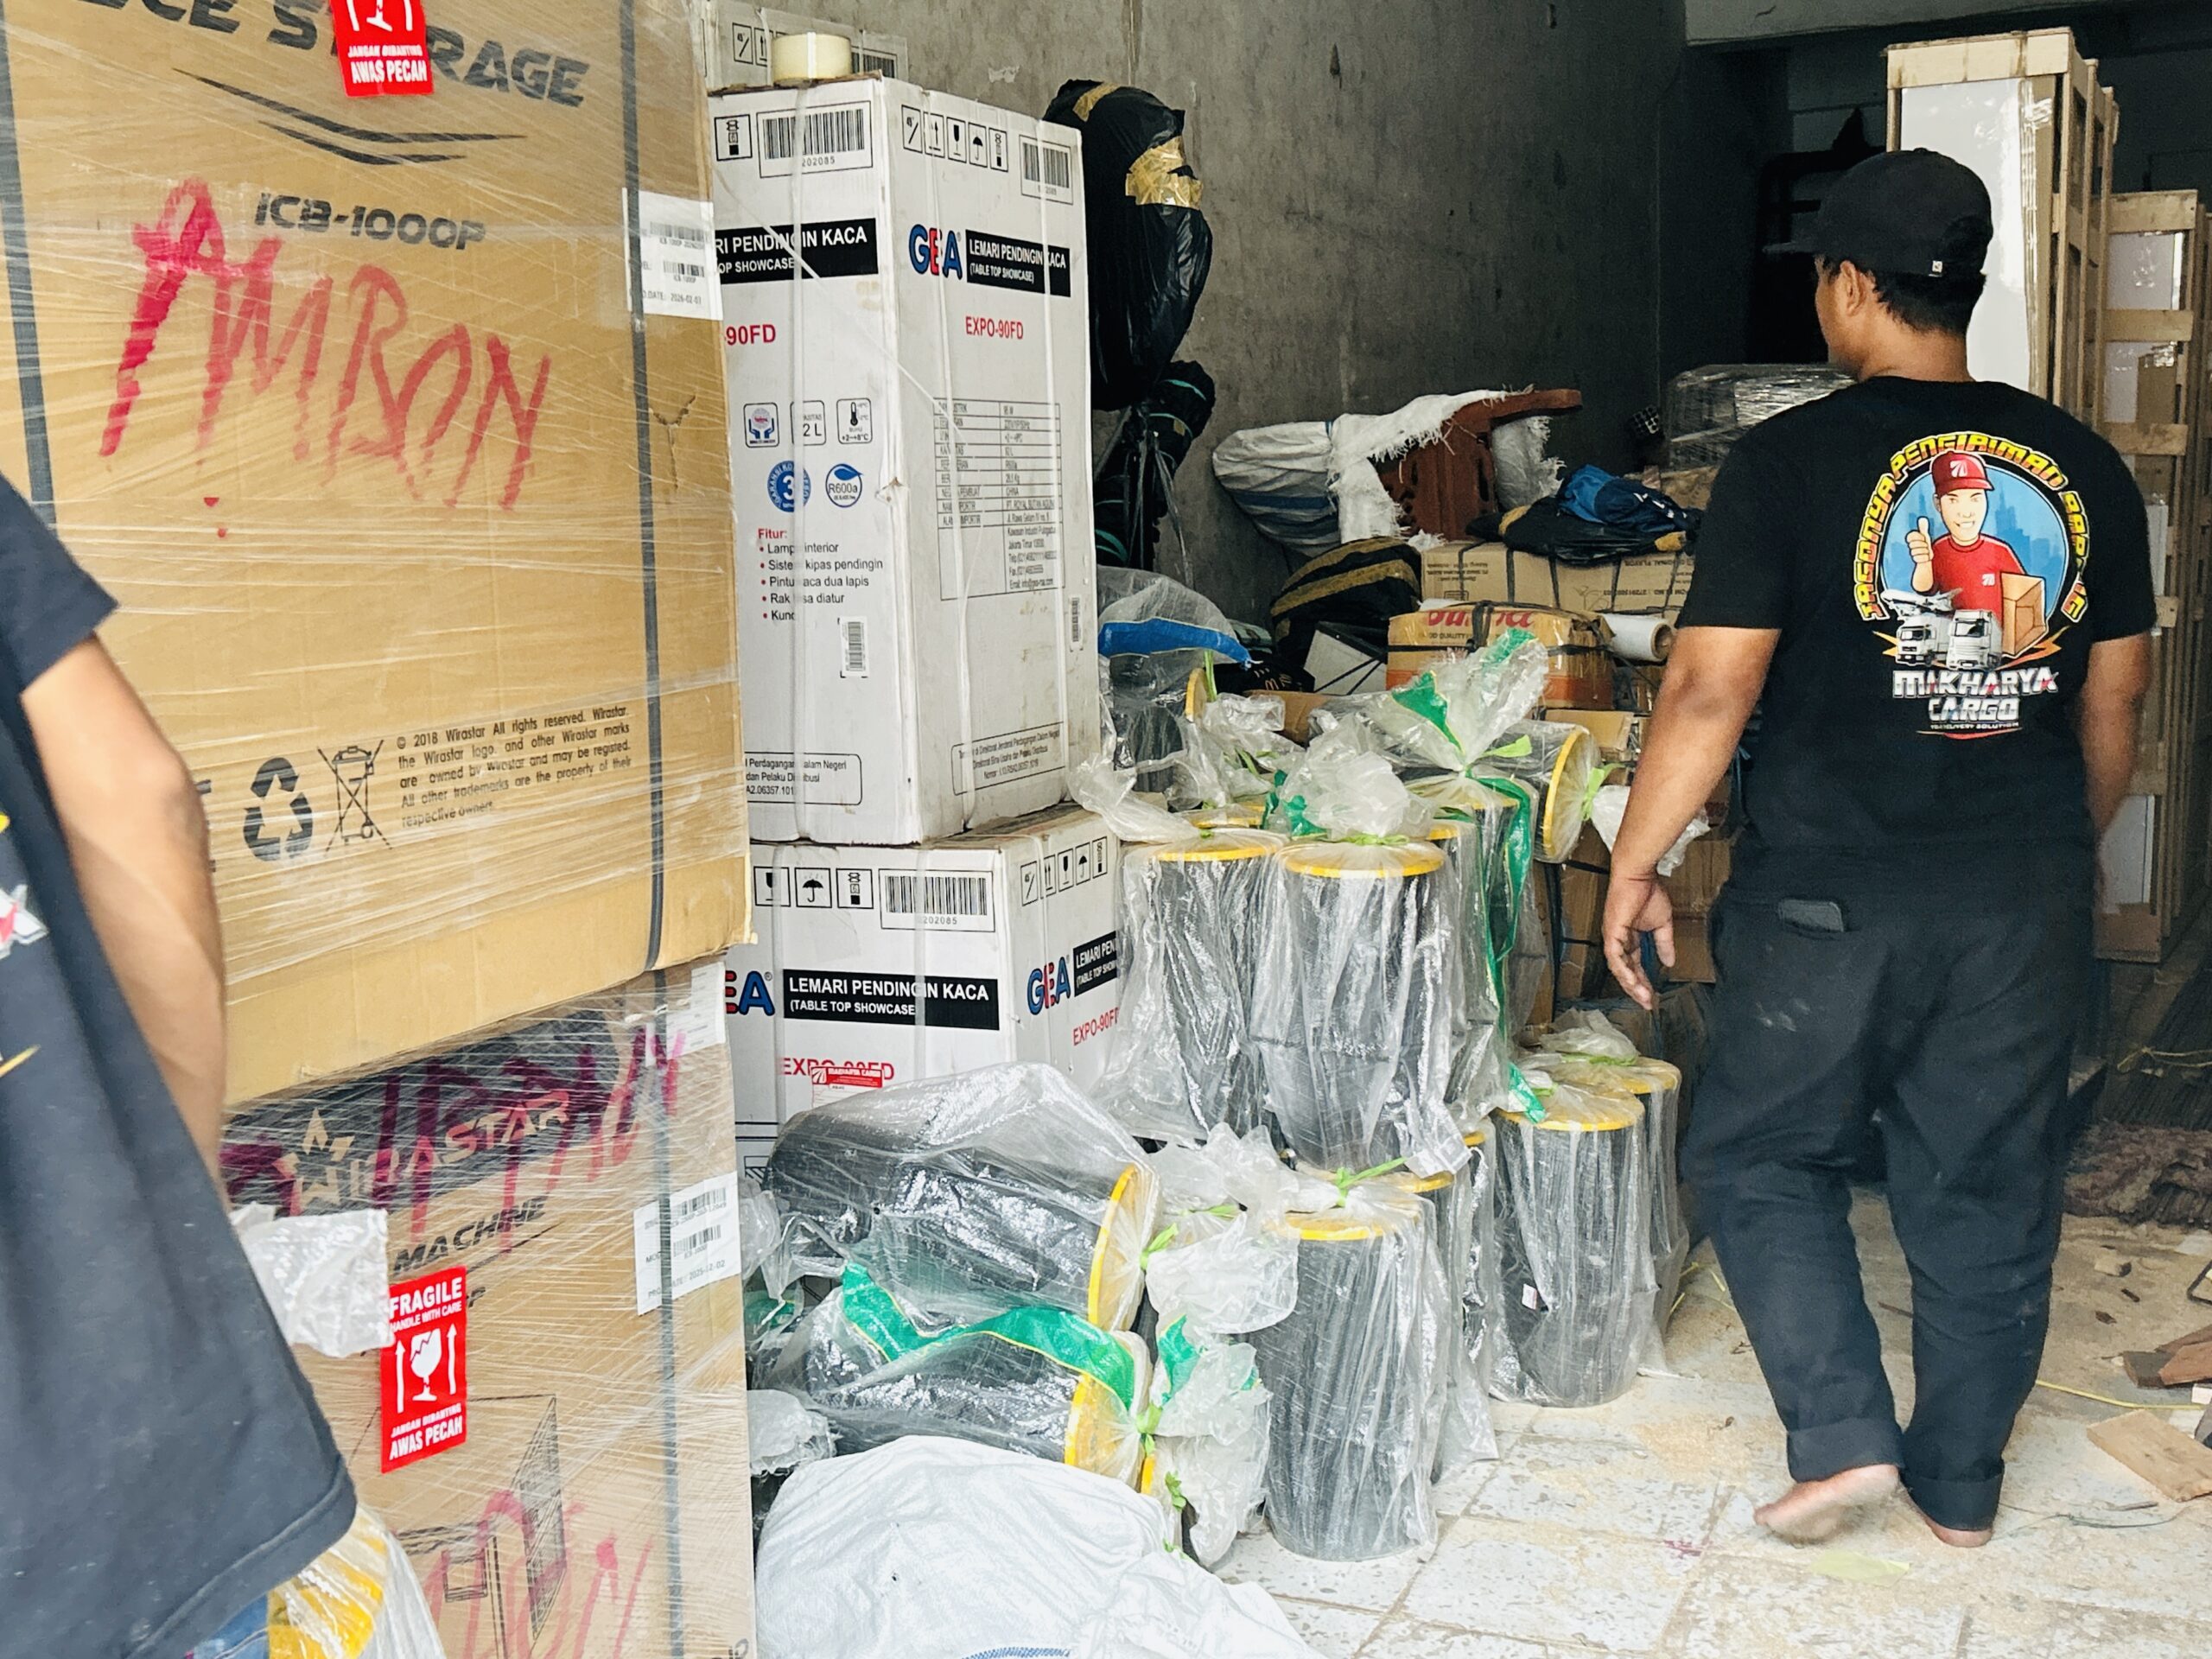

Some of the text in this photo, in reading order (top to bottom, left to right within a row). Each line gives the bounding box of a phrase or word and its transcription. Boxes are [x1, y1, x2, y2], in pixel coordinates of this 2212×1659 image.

[352, 60, 427, 84] AWAS PECAH
[254, 192, 486, 251] ICB-1000P
[822, 226, 868, 246] KACA
[969, 238, 1000, 258] LEMARI
[1001, 244, 1043, 266] PENDINGIN
[734, 257, 795, 273] SHOWCASE
[990, 265, 1001, 276] TOP
[965, 315, 1023, 340] EXPO-90FD
[1890, 431, 2068, 490] PENGIRIMAN
[782, 474, 795, 500] 3
[829, 482, 858, 494] R600a
[758, 528, 788, 539] Fitur:
[767, 543, 839, 556] Lamp interior
[768, 558, 883, 572] Siste kipas pendingin
[769, 576, 869, 588] Pintu aca dua lapis
[770, 593, 791, 604] Rak
[816, 593, 845, 604] diatur
[1892, 666, 2060, 698] MAKHARYA
[1928, 697, 2020, 722] CARGO
[414, 732, 439, 747] 2018
[446, 727, 486, 742] Wirastar
[493, 722, 505, 735] All
[512, 717, 538, 734] rights
[544, 711, 586, 728] reserved.
[398, 755, 416, 769] the
[423, 748, 465, 766] Wirastar
[505, 737, 524, 753] and
[531, 734, 556, 749] other
[562, 729, 597, 743] Wirastar
[604, 722, 630, 737] marks
[400, 775, 418, 789] are
[429, 768, 464, 784] owned
[529, 753, 548, 766] and
[552, 749, 573, 764] may
[577, 745, 589, 759] be
[761, 772, 785, 782] Pelaku
[823, 760, 846, 771] Negeri
[401, 753, 632, 809] All other trademarks are the property of their
[1075, 943, 1102, 969] LEMARI
[789, 977, 848, 995] LEMARI
[943, 983, 989, 1001] KACA
[1027, 957, 1071, 1015] GEA
[790, 1000, 916, 1015] (TABLE TOP SHOWCASE
[389, 1276, 462, 1319] FRAGILE
[422, 1307, 441, 1324] WITH
[442, 1300, 462, 1315] CARE
[390, 1415, 462, 1460] AWAS PECAH
